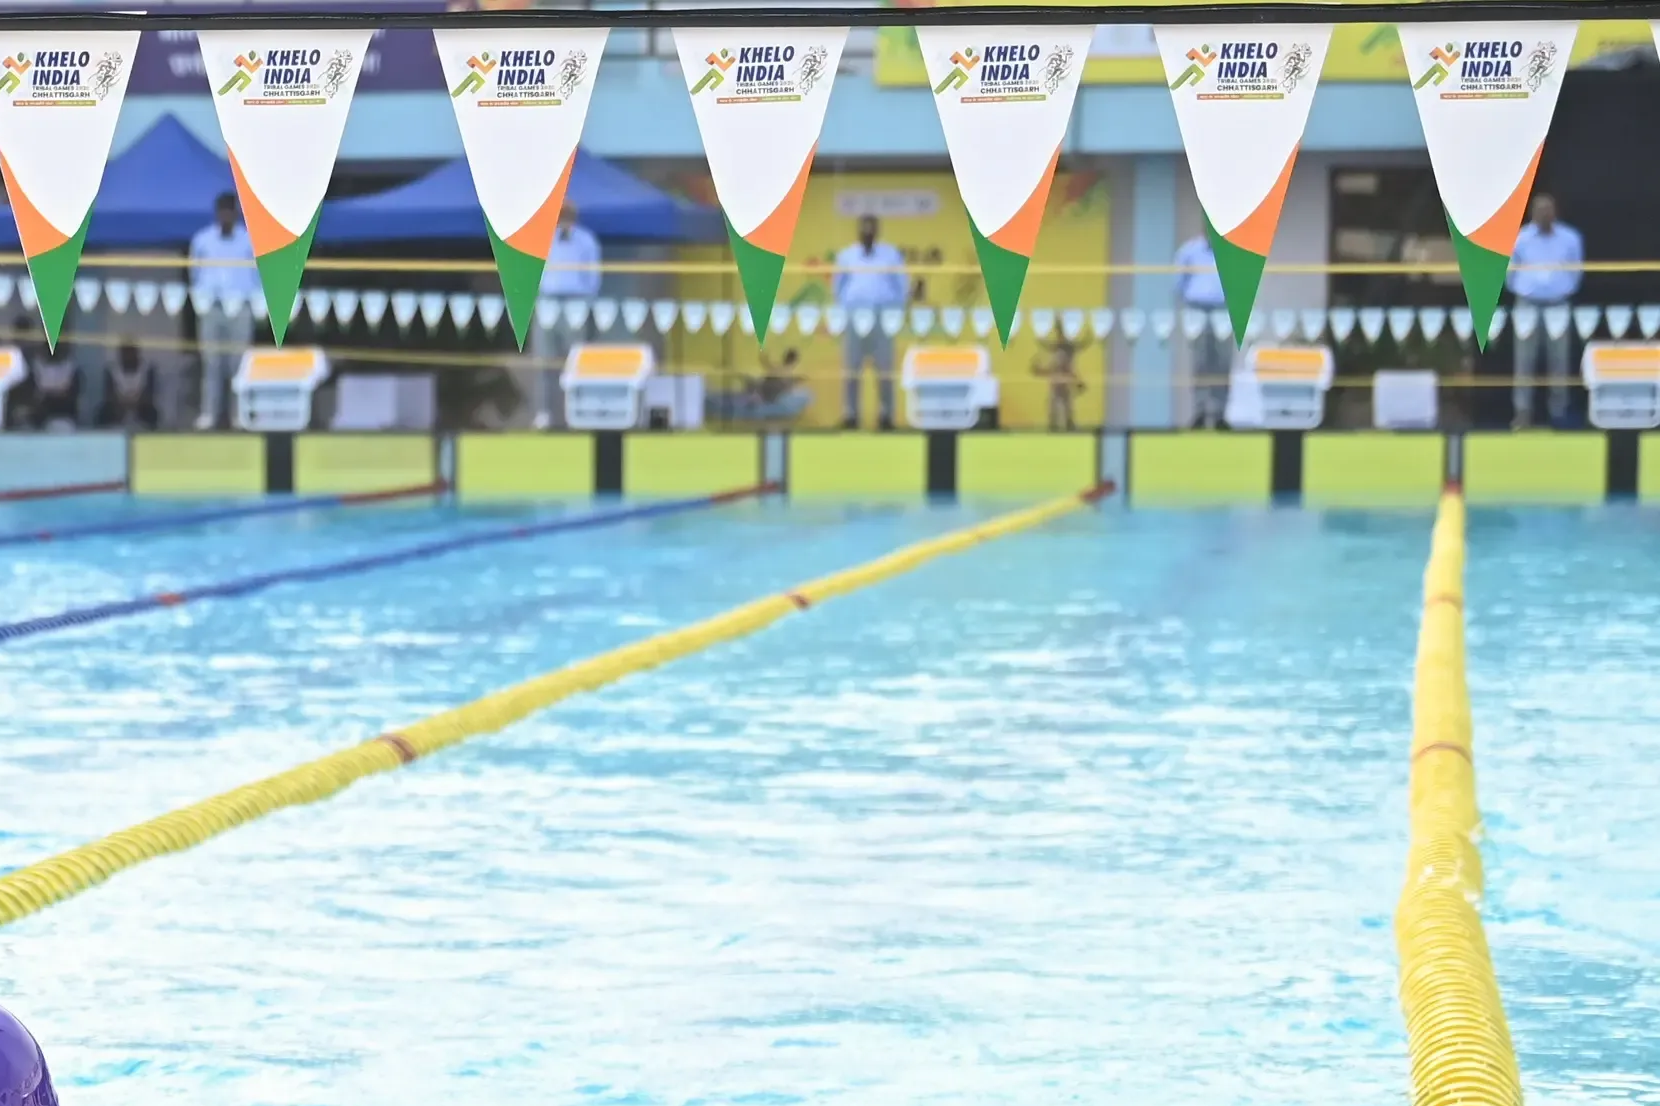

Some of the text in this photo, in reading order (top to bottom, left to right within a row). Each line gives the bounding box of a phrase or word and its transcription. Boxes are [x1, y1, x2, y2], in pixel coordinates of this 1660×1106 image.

[267, 49, 321, 66] KHELO
[739, 46, 794, 63] KHELO
[984, 45, 1040, 62] KHELO
[1221, 43, 1278, 59] KHELO
[1465, 41, 1522, 58] KHELO
[35, 51, 90, 67] KHELO
[500, 50, 555, 67] KHELO
[264, 68, 311, 84] INDIA
[497, 69, 545, 85] INDIA
[736, 65, 784, 82] INDIA
[981, 64, 1029, 81] INDIA
[1218, 62, 1267, 78] INDIA
[1461, 61, 1511, 77] INDIA
[33, 70, 80, 85] INDIA
[981, 86, 1039, 94] CHHATTISGARH
